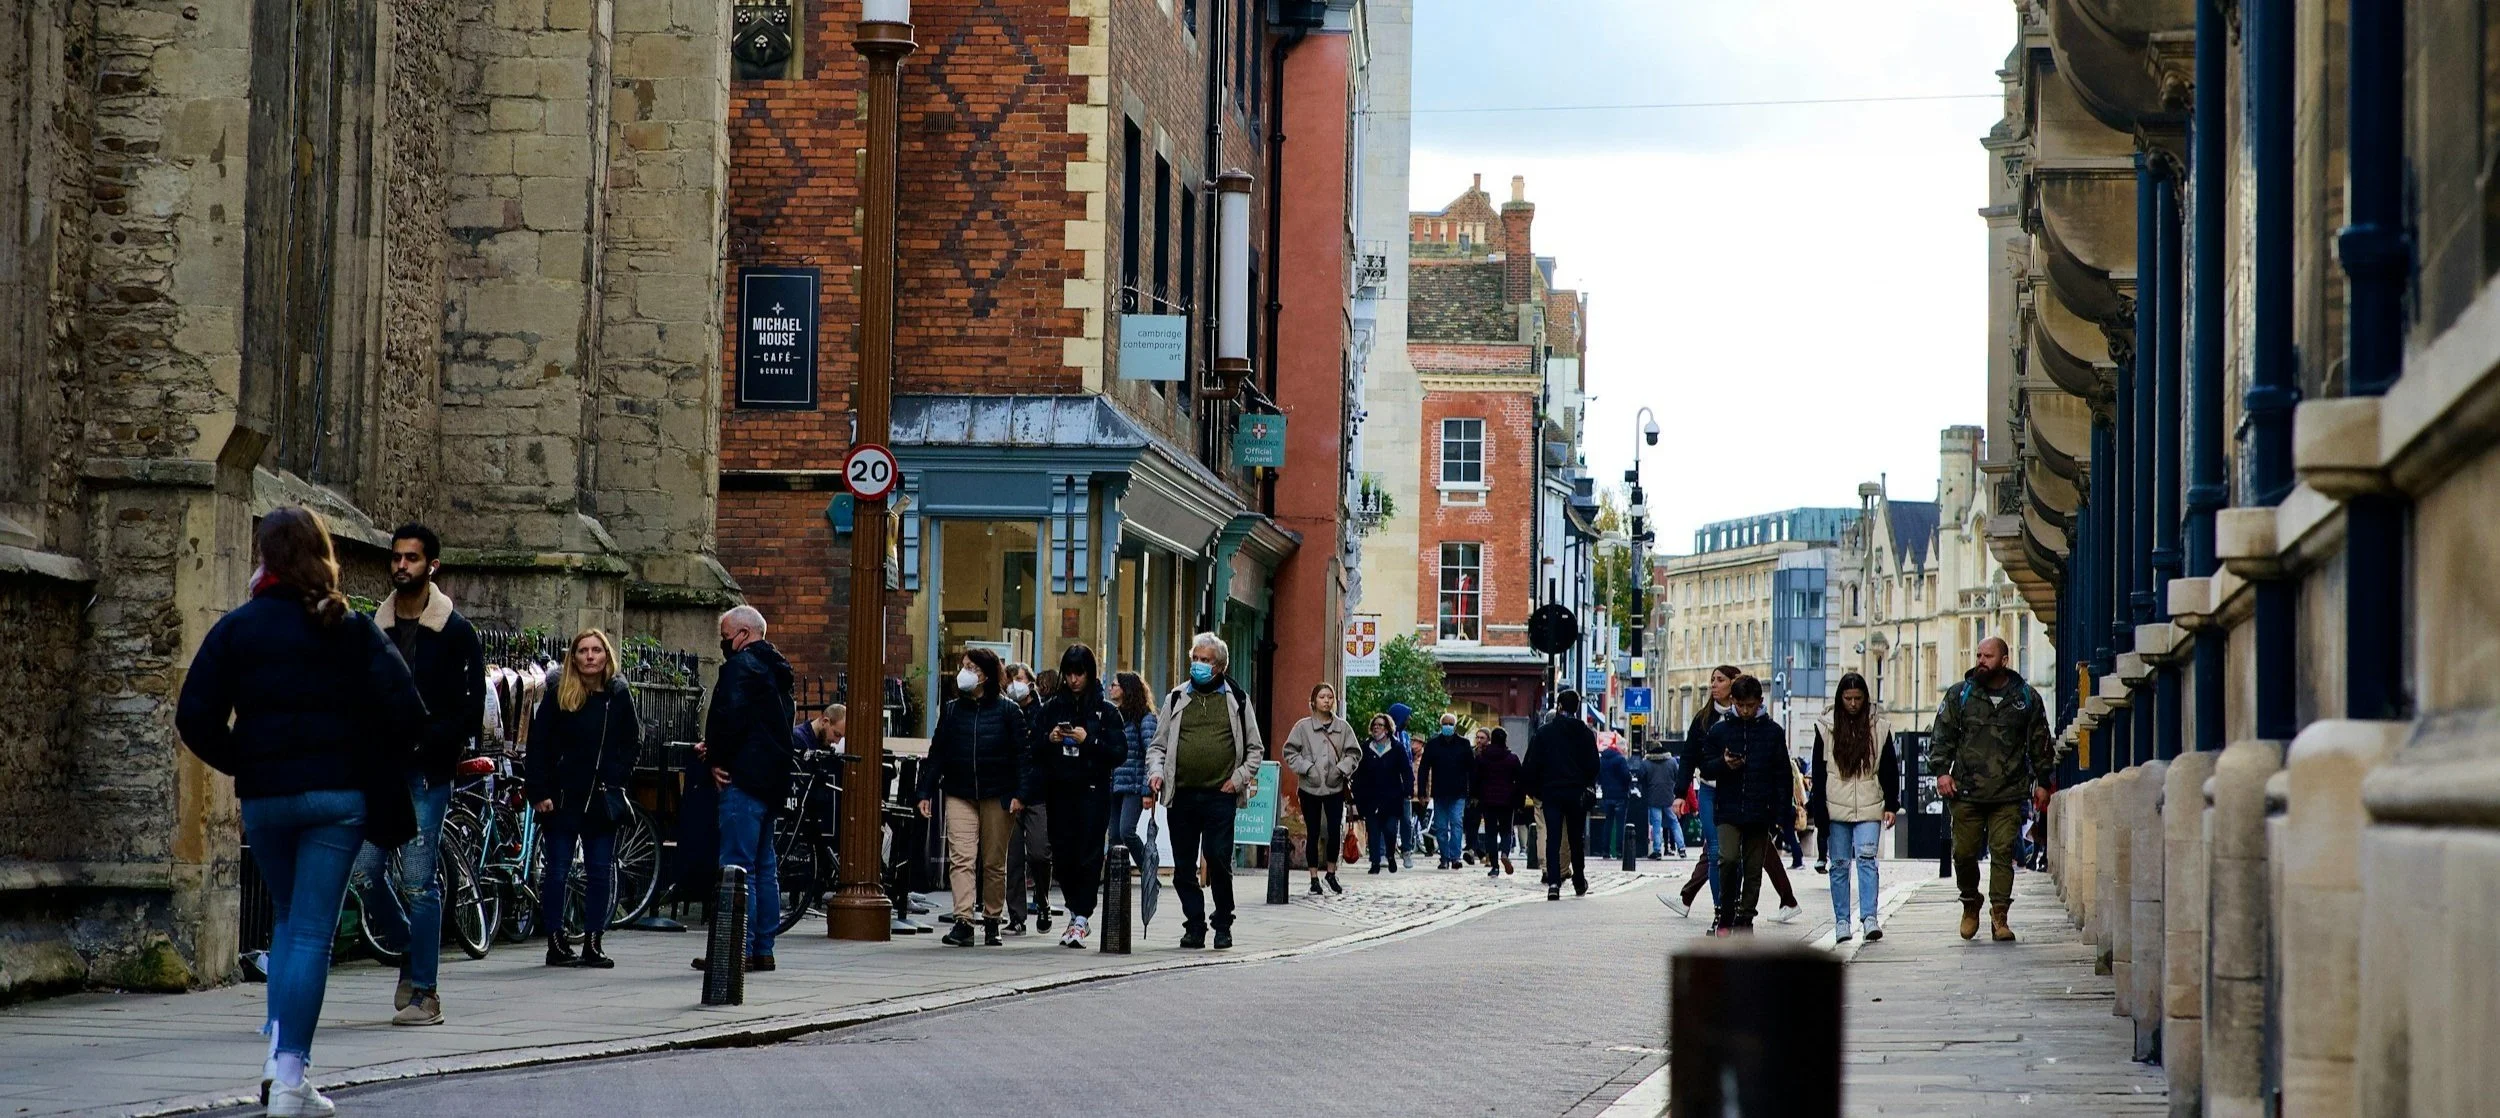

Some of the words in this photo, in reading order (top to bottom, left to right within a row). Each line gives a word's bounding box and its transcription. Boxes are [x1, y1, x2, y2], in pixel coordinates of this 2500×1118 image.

[752, 317, 802, 332] MICHAEL
[758, 332, 796, 346] HOUSE
[1137, 329, 1182, 339] cambridge
[1123, 341, 1182, 350] contemporary
[763, 352, 791, 362] CAFÉ
[1168, 353, 1182, 361] art
[1244, 447, 1272, 455] Official
[1243, 455, 1273, 463] Apparel
[851, 460, 889, 482] 20
[1234, 825, 1265, 836] pparel
